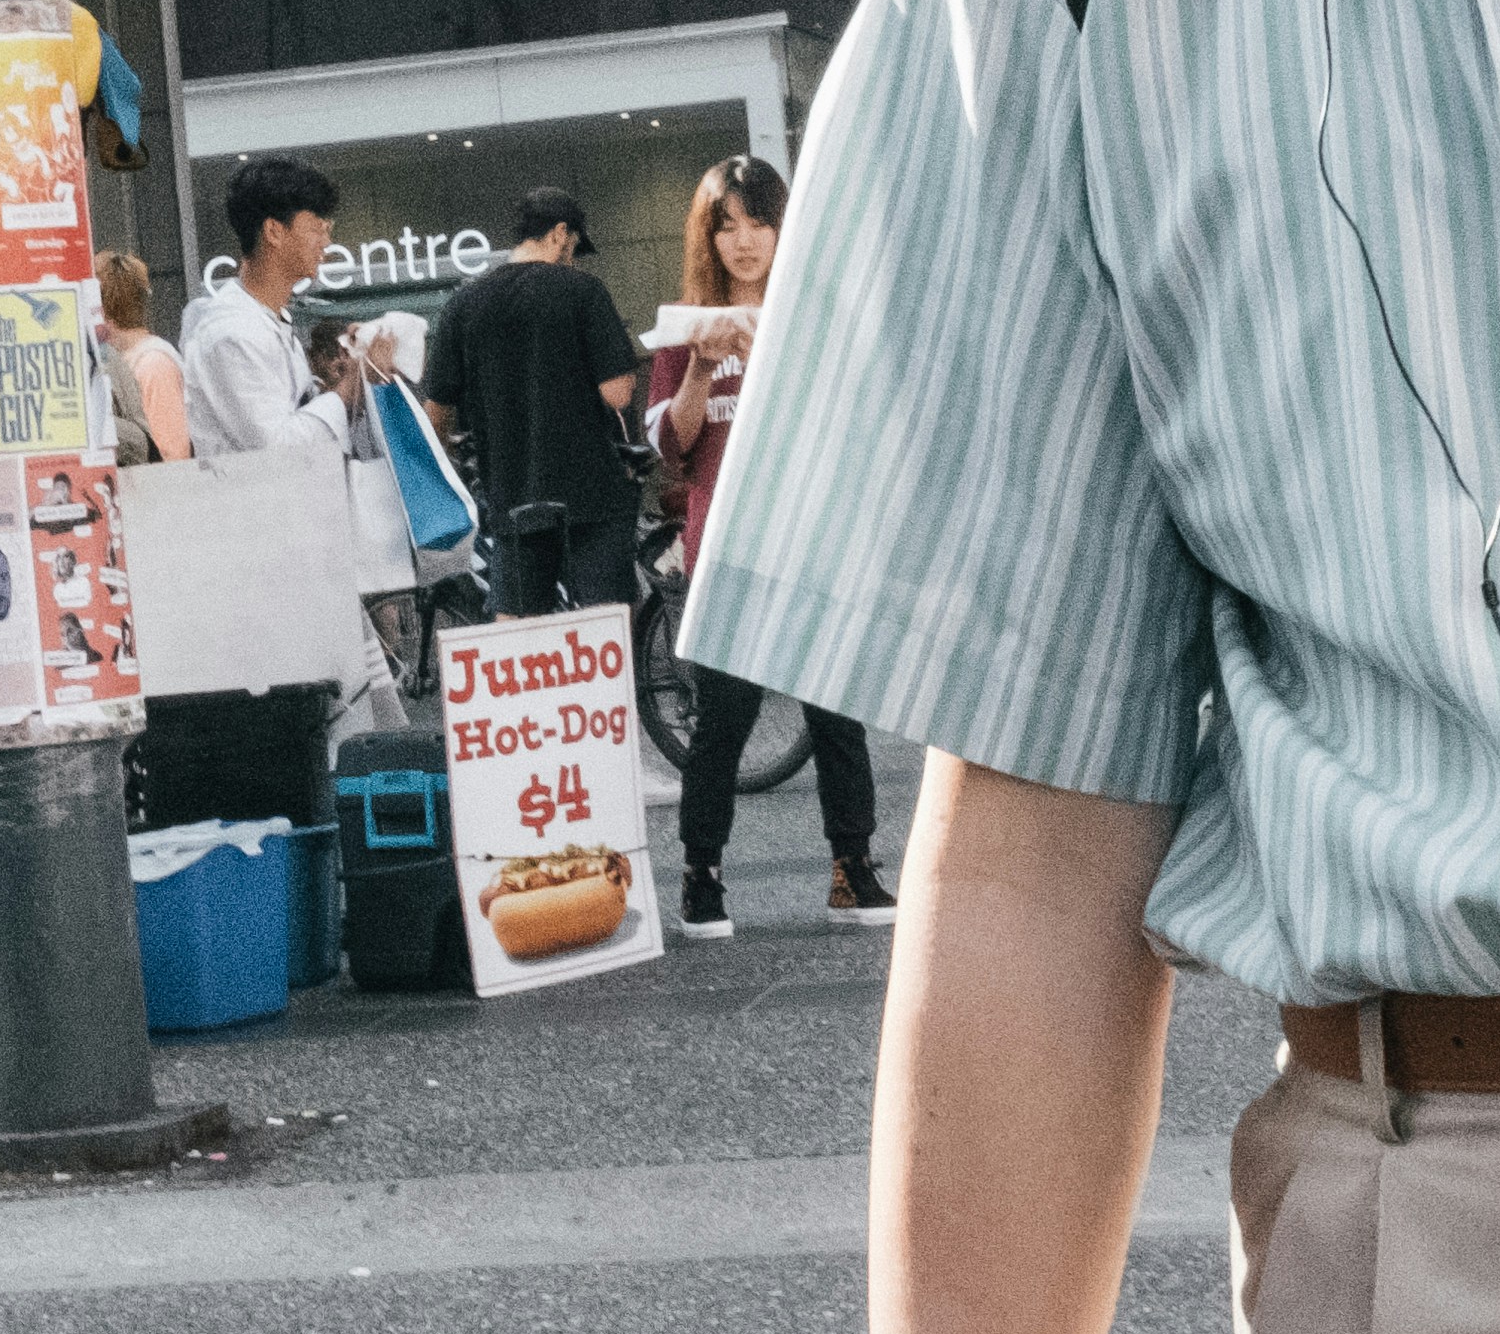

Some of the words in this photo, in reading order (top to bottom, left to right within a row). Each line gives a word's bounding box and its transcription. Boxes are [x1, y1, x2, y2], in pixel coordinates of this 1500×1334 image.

[448, 629, 624, 704] Jumbo
[453, 703, 627, 762] Hot-Dog
[518, 763, 591, 838] $4
